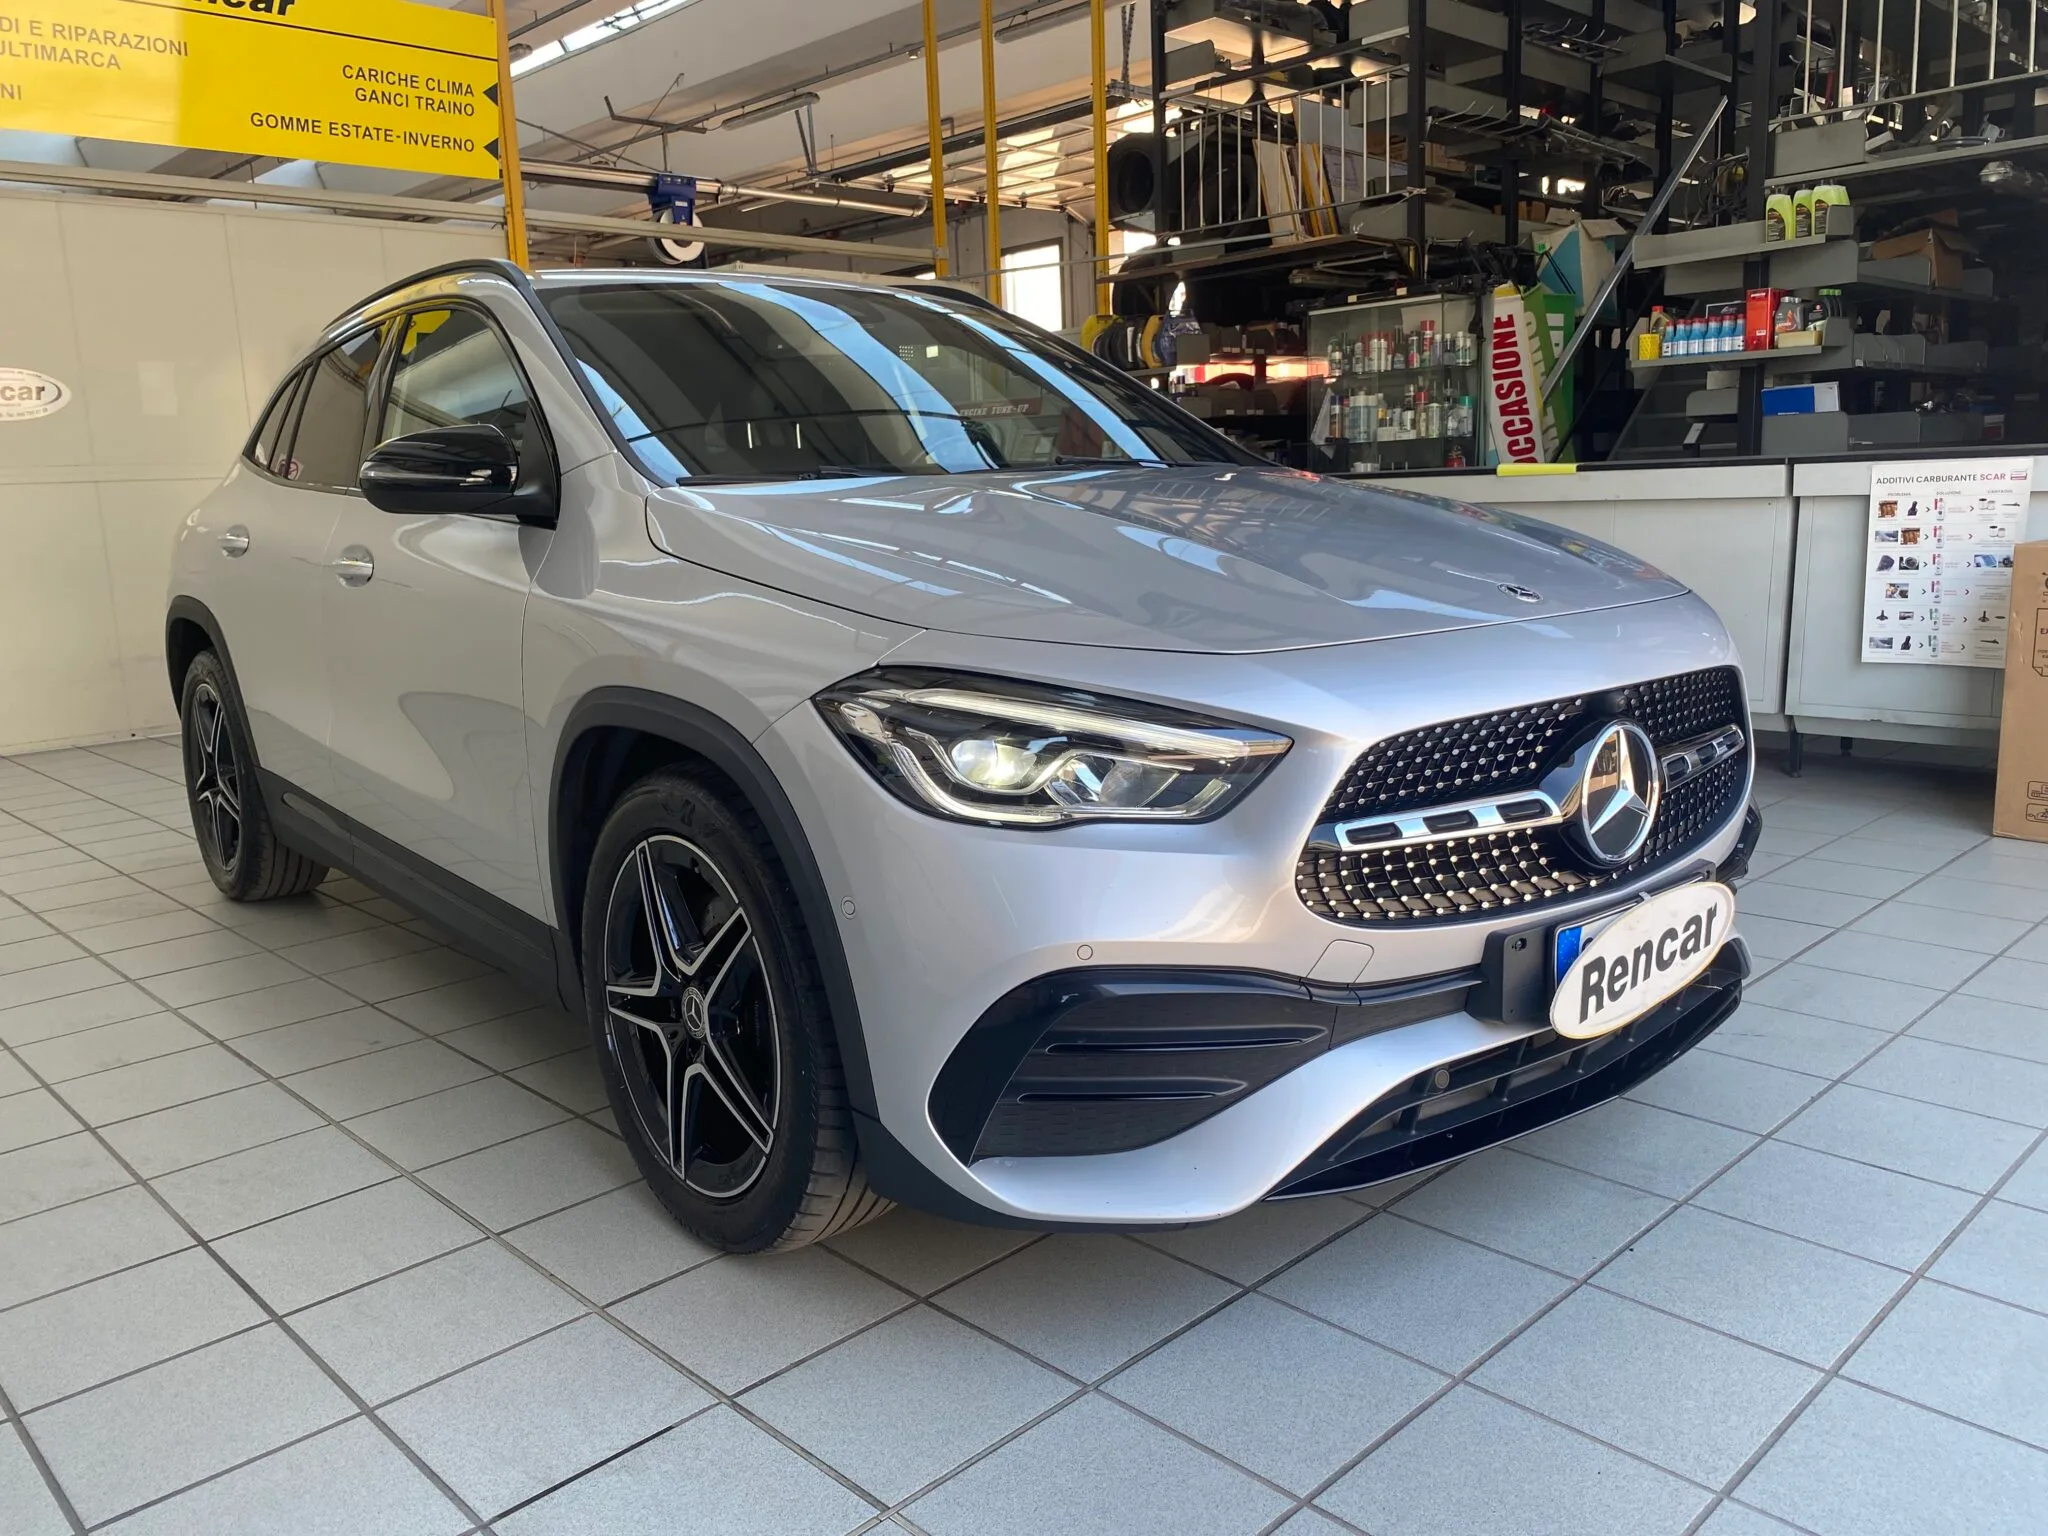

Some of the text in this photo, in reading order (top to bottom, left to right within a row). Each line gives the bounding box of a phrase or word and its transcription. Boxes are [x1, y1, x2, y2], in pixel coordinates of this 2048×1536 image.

[29, 20, 43, 37] E
[52, 23, 188, 56] RIPARAZIONI
[342, 64, 475, 97] CARICHE CLIMA
[355, 87, 475, 117] GANCI TRAINO
[250, 112, 475, 152] GOMME ESTATE-INVERNO
[1876, 476, 1914, 485] ADDITIVI
[1916, 474, 1977, 483] CARBURANTE
[1980, 472, 2006, 481] SCAR
[1579, 902, 1718, 1024] Rencar
